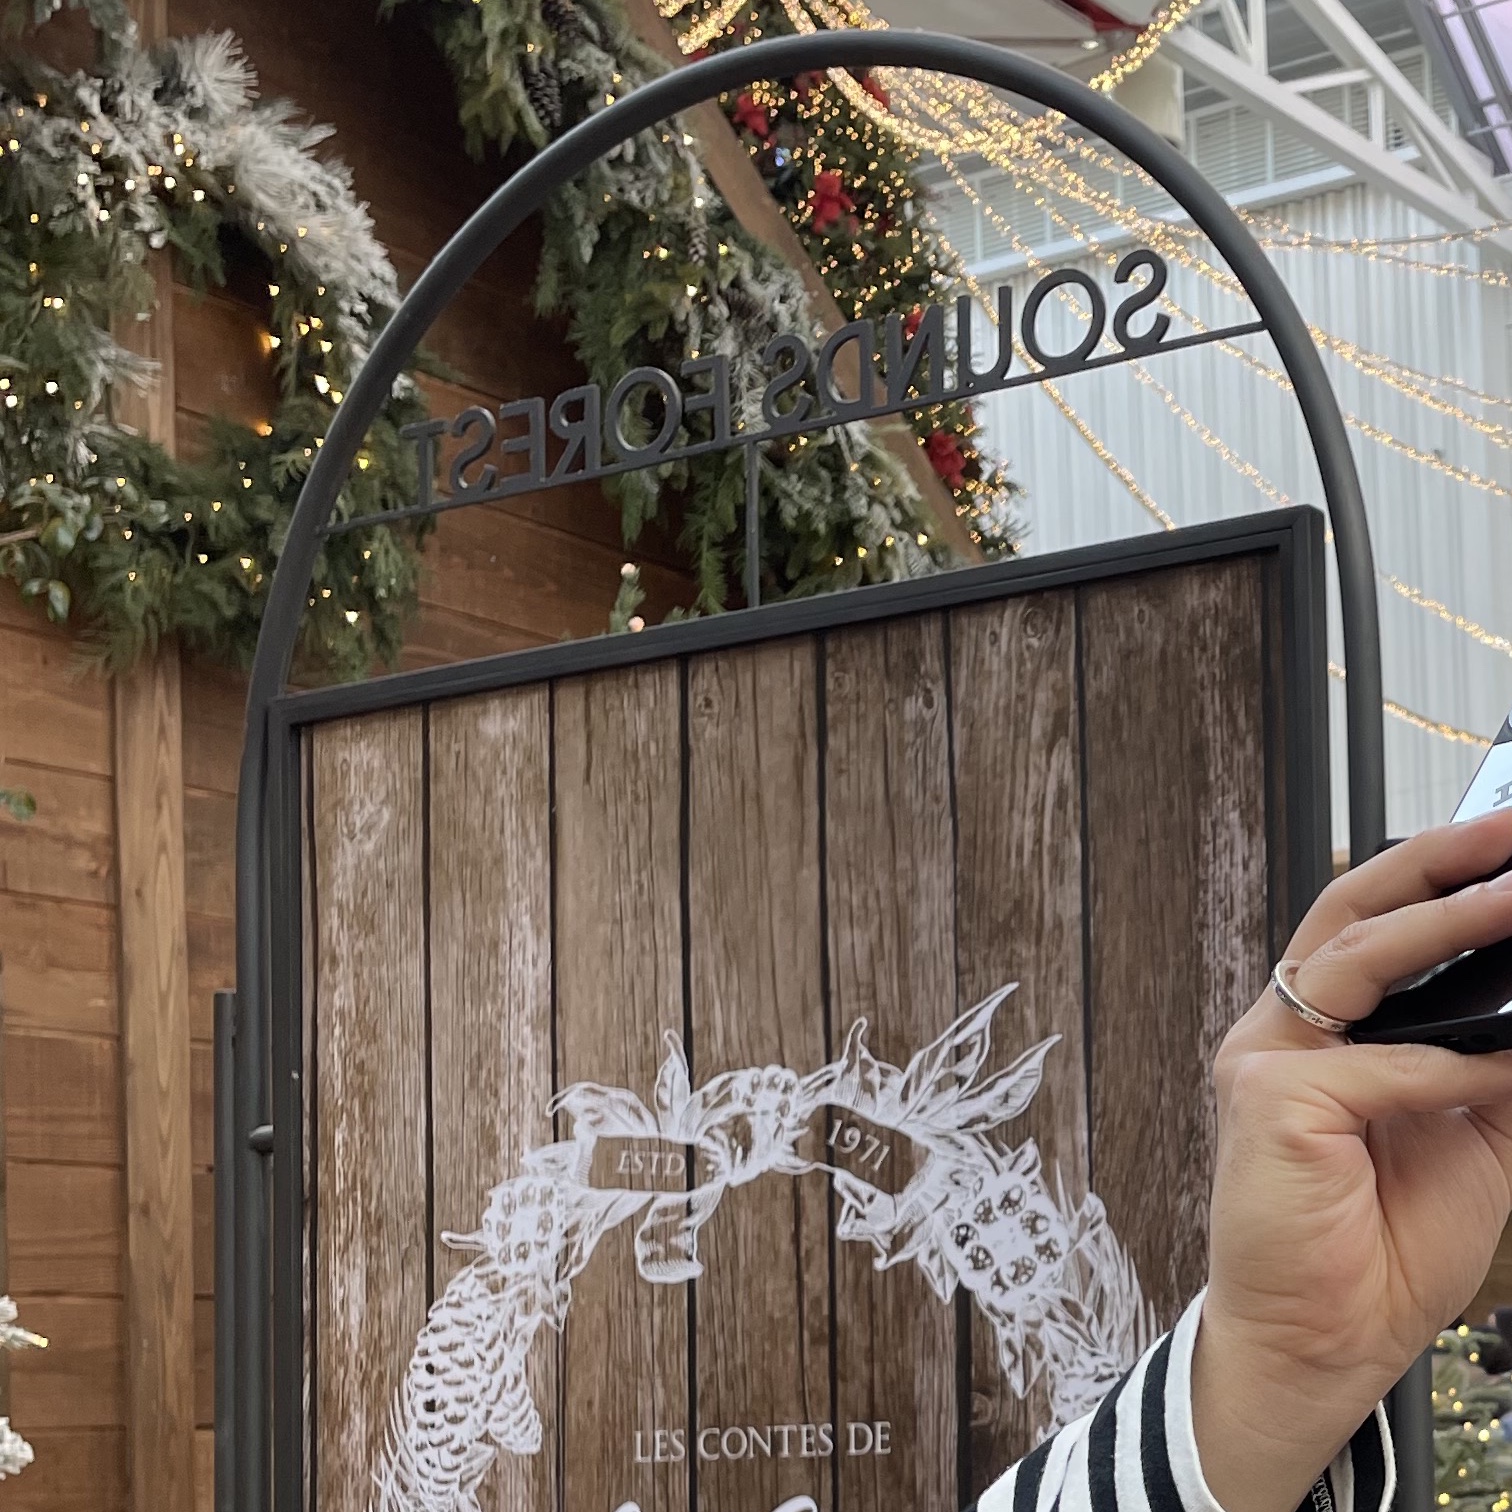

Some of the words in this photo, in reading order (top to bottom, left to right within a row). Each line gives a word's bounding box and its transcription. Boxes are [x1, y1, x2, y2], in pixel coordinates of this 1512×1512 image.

[617, 1149, 687, 1177] ESTD
[826, 1118, 891, 1173] 1971
[634, 1428, 686, 1463] LES
[697, 1422, 834, 1461] CONTES
[846, 1420, 892, 1456] DE
